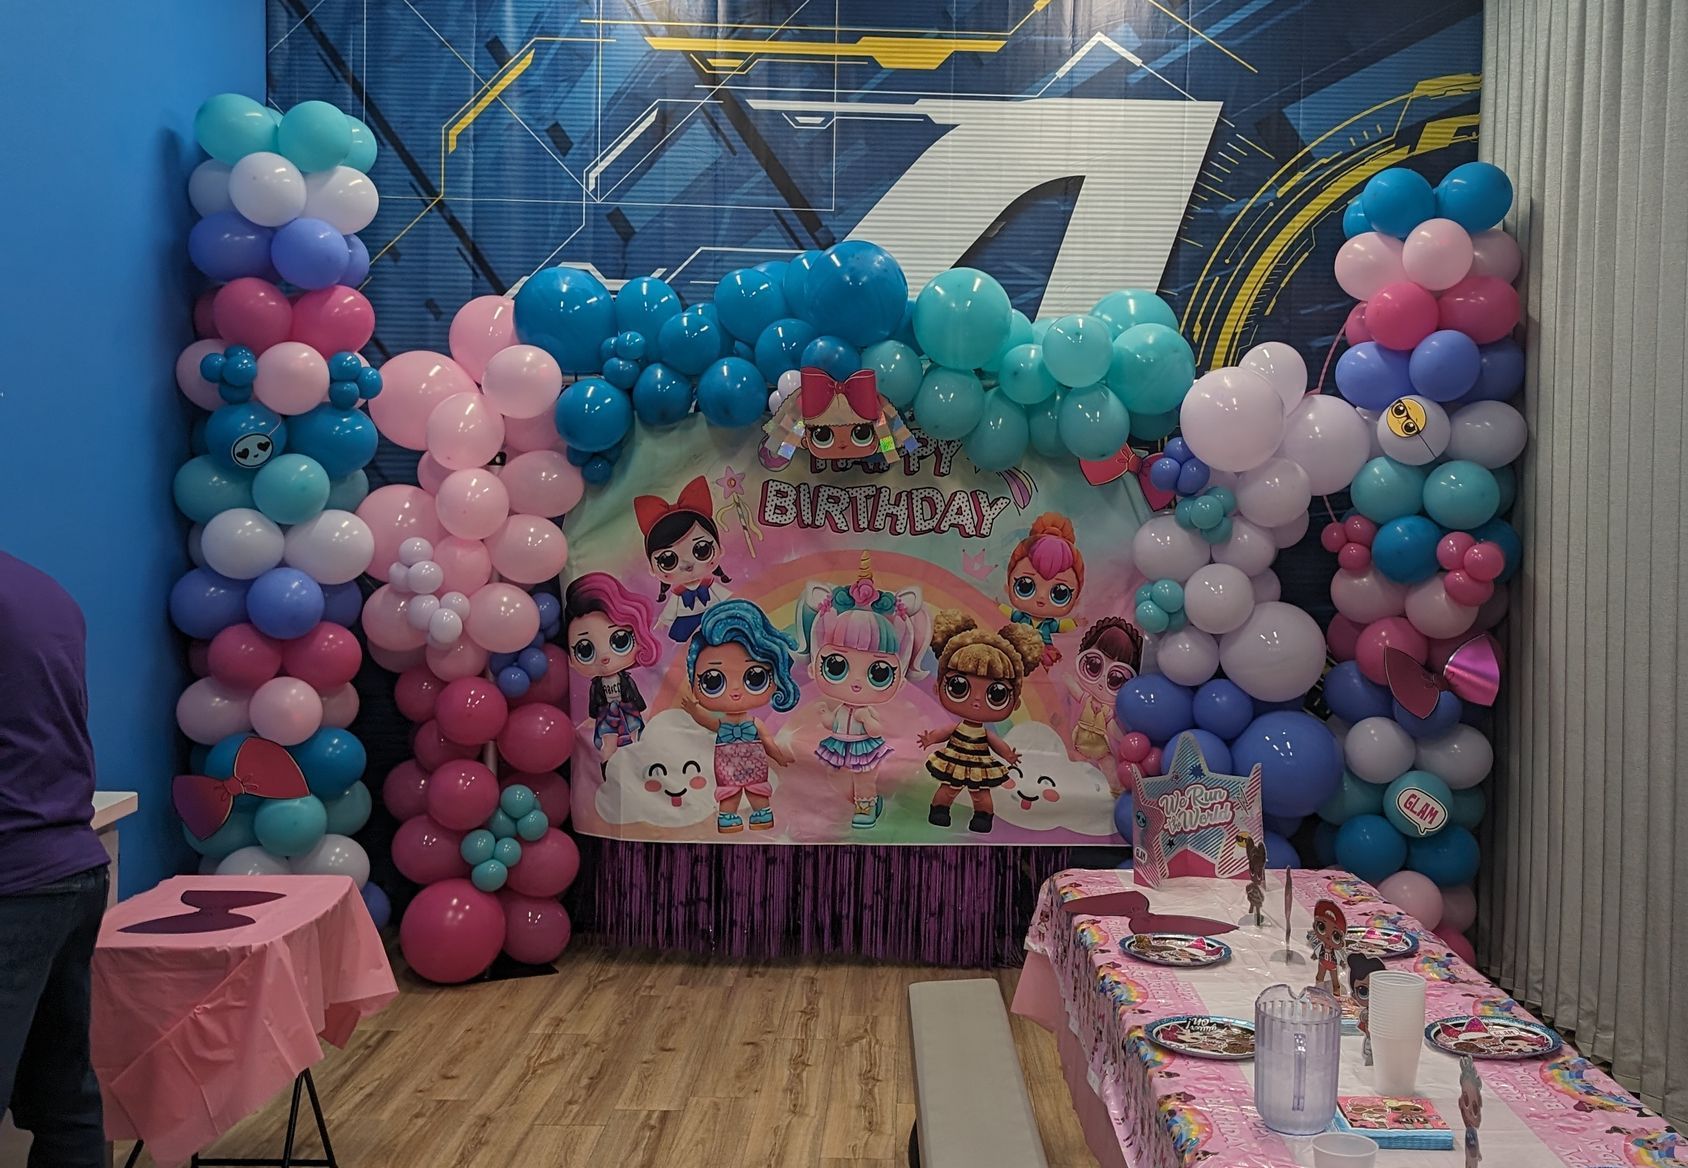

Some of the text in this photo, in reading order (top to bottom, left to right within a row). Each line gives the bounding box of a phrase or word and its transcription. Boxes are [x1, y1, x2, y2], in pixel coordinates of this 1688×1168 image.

[758, 479, 1011, 538] BIRTHDAY
[1159, 784, 1228, 816] We Run
[1404, 793, 1439, 825] GLAM
[1164, 802, 1233, 835] the World
